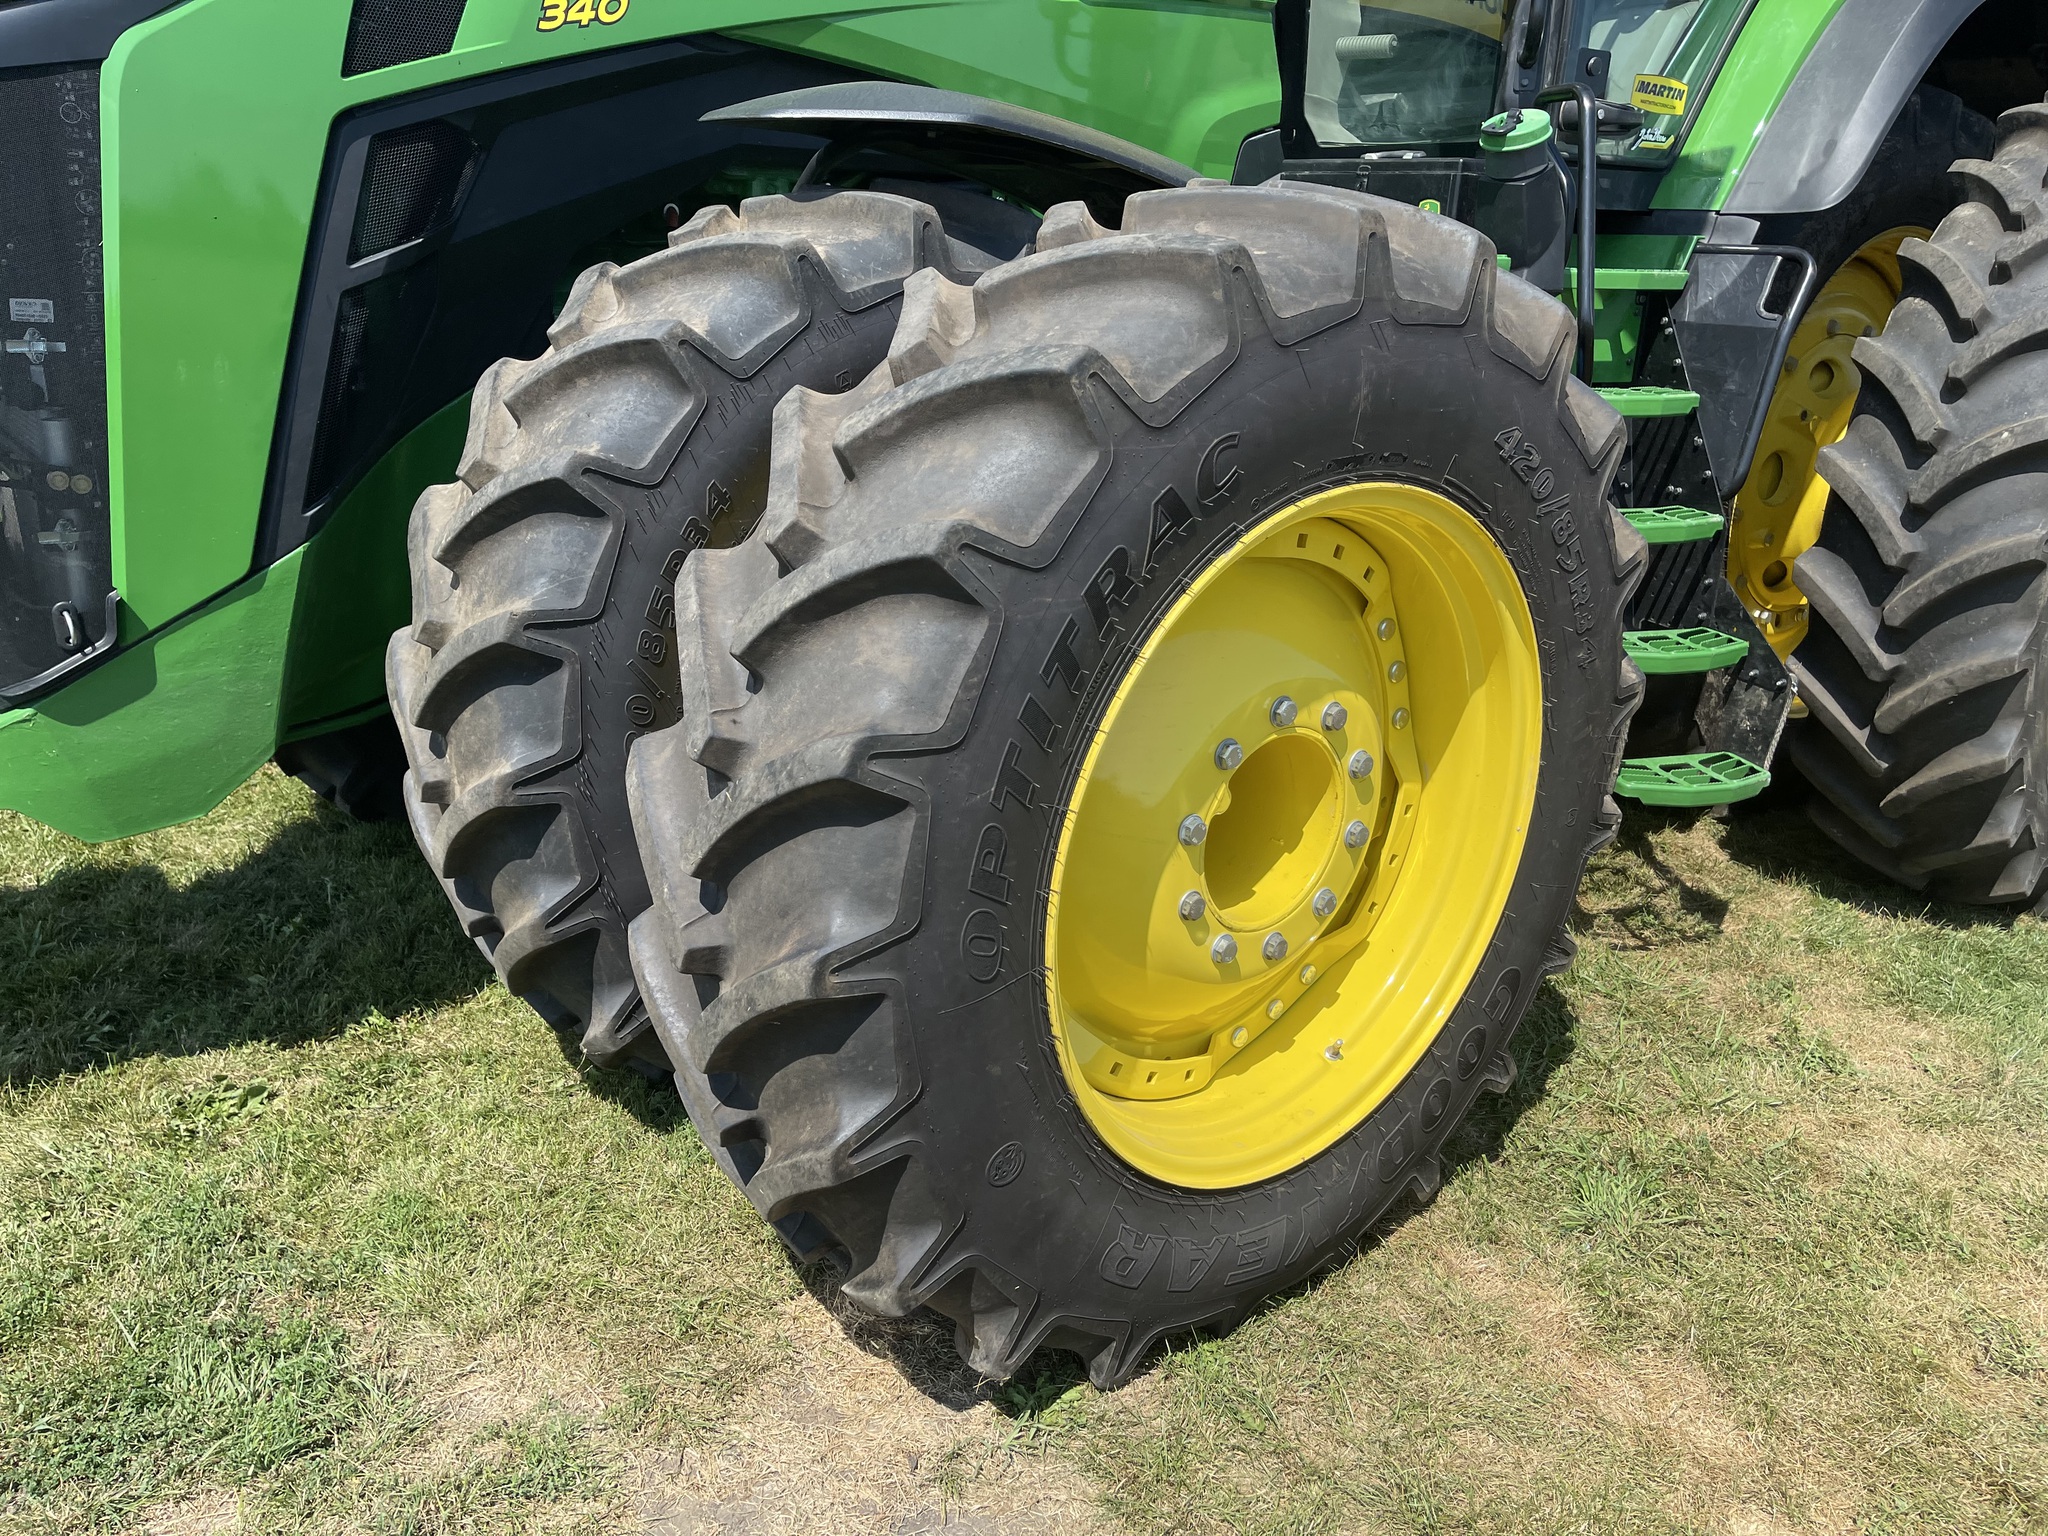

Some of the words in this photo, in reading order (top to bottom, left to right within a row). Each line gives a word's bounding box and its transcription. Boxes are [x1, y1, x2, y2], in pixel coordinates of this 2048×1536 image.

[537, 0, 630, 32] 340
[1637, 80, 1685, 101] MARTIN
[1494, 426, 1598, 671] 420/85R34
[959, 431, 1242, 983] OPTITRAC
[1075, 661, 1109, 722] ROTATION
[1100, 966, 1521, 1293] GOODYEAR
